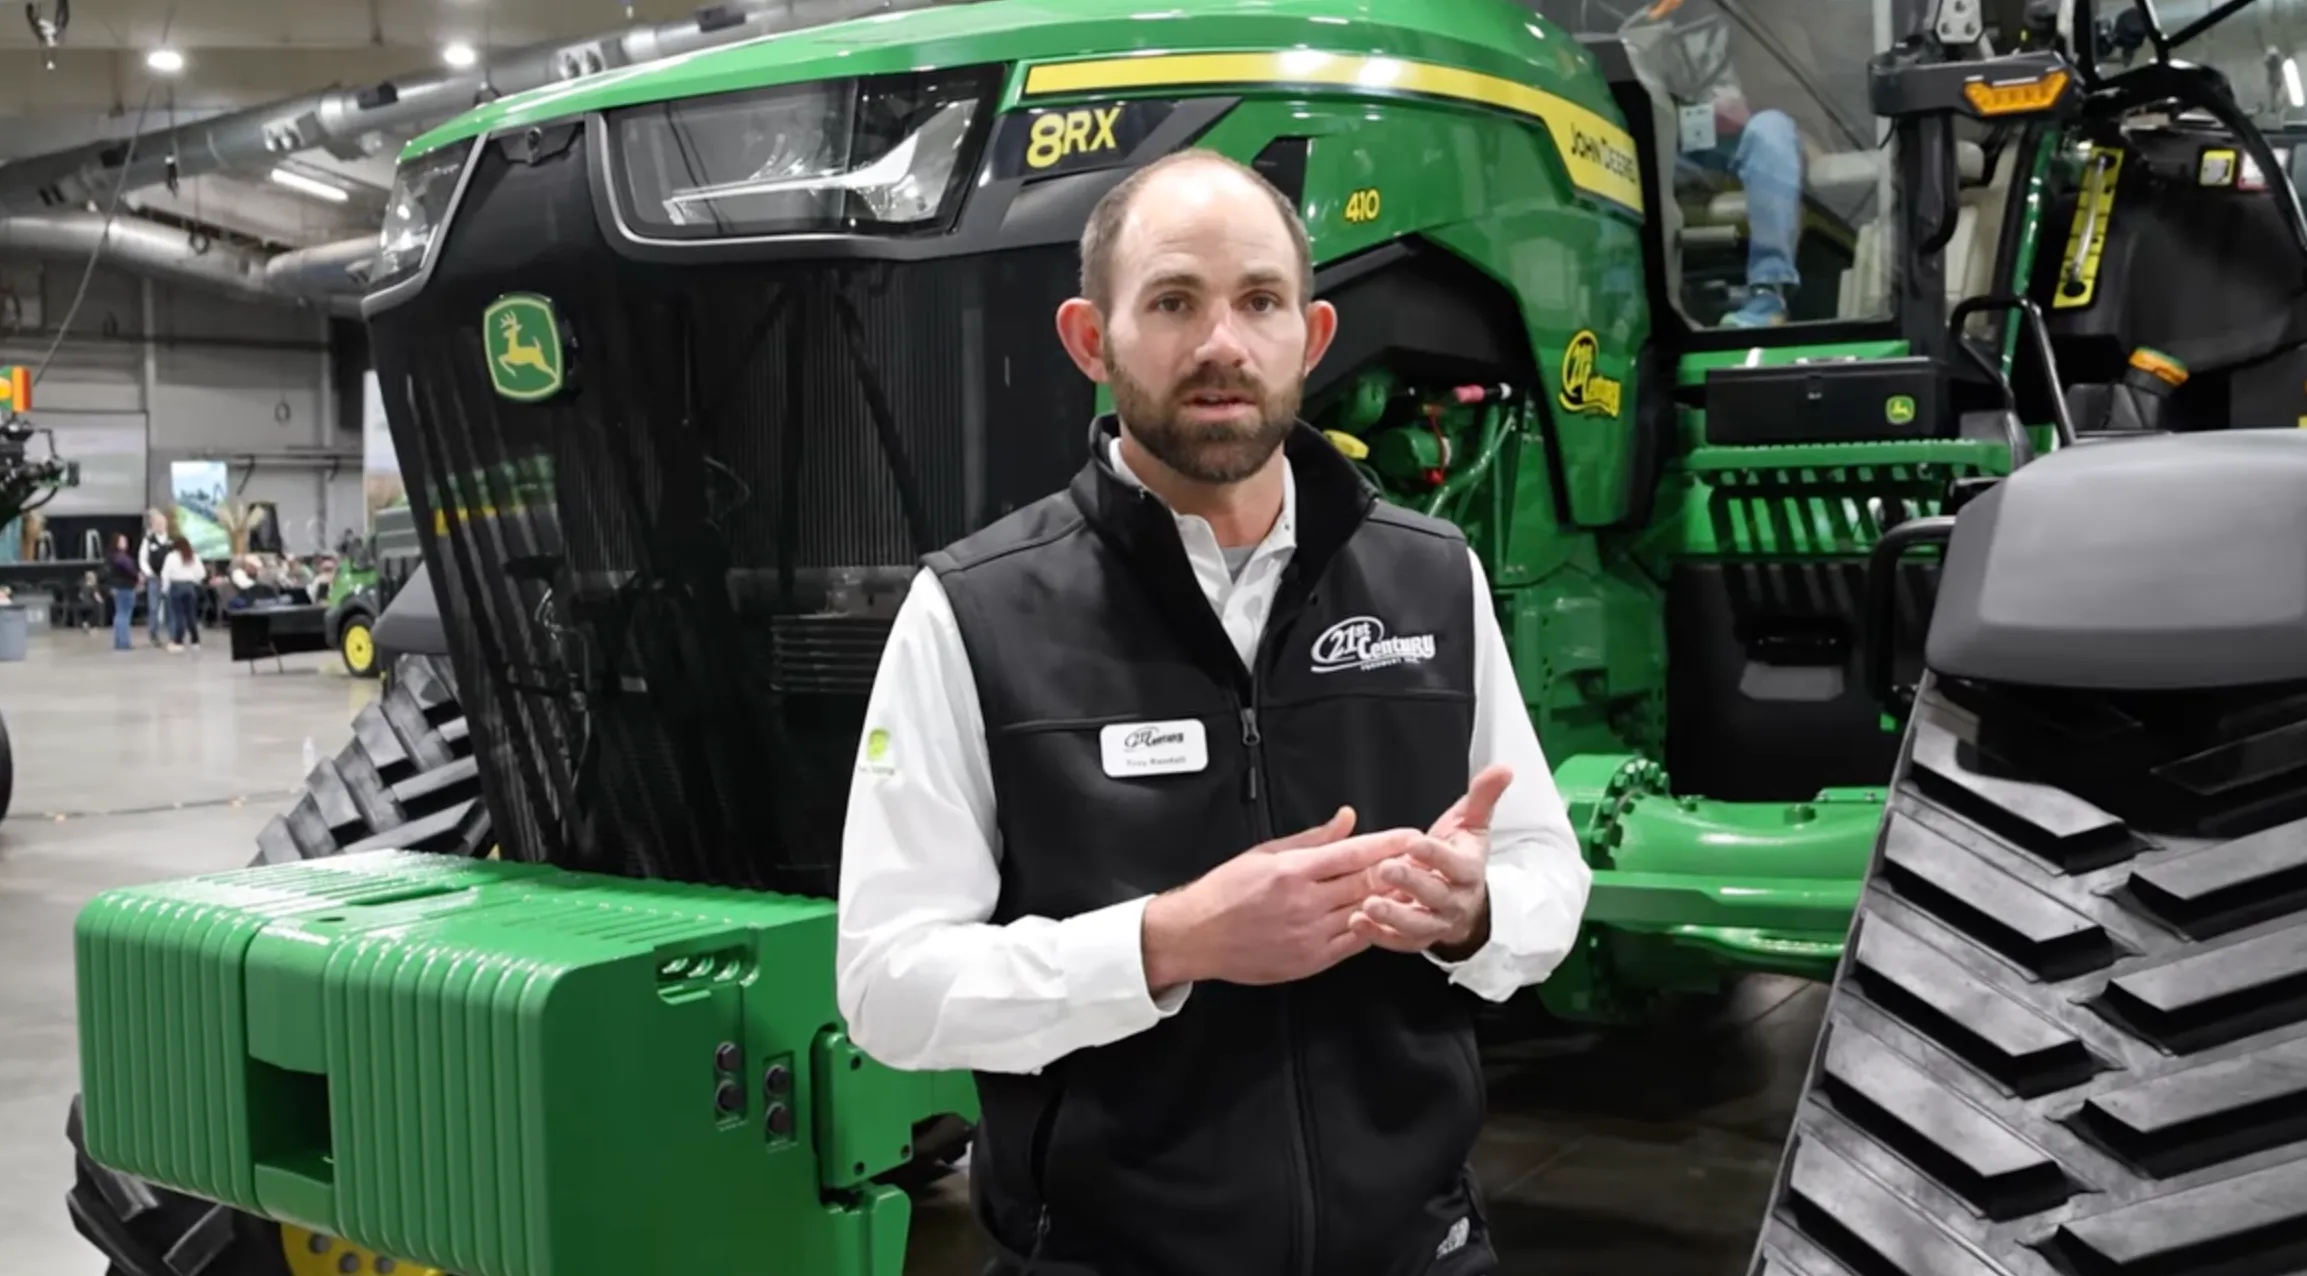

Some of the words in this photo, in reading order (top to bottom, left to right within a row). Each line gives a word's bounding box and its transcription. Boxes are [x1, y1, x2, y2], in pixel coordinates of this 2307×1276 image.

[1026, 106, 1121, 168] 8RX
[1569, 121, 1601, 166] JOHN
[1601, 136, 1637, 185] DEERE
[1344, 188, 1380, 222] 410
[1327, 621, 1371, 660] 21st
